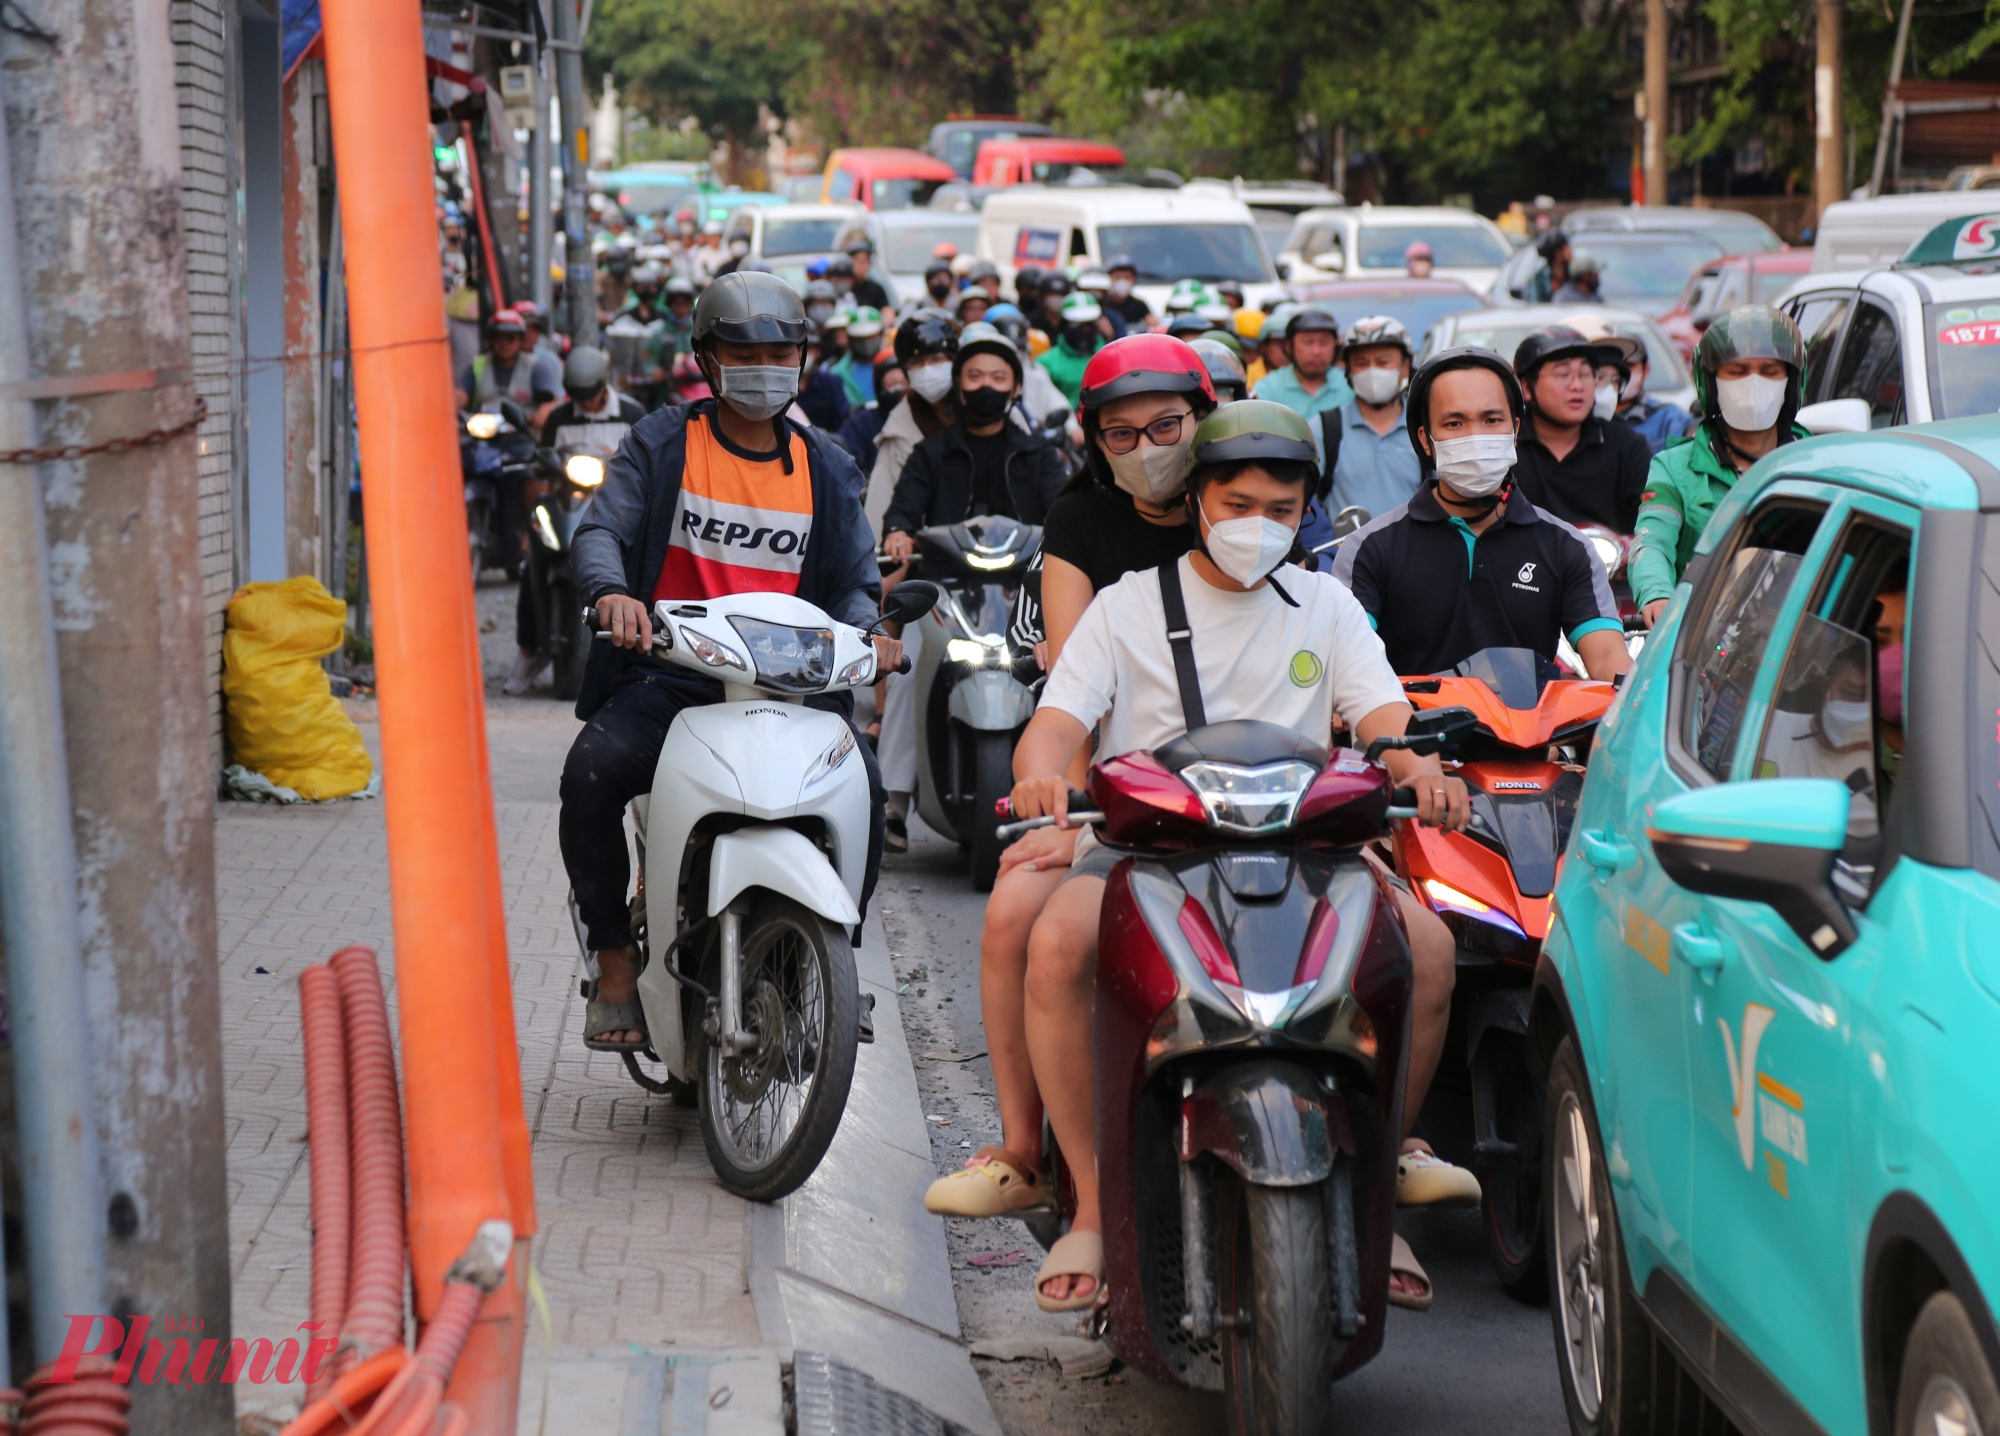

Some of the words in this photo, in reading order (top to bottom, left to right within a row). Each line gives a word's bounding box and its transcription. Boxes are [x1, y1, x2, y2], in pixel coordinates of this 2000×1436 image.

[1511, 582, 1540, 592] PETRONAS
[744, 707, 788, 718] HONDA
[1494, 781, 1542, 790] HONDA
[1232, 856, 1277, 864] HONDA
